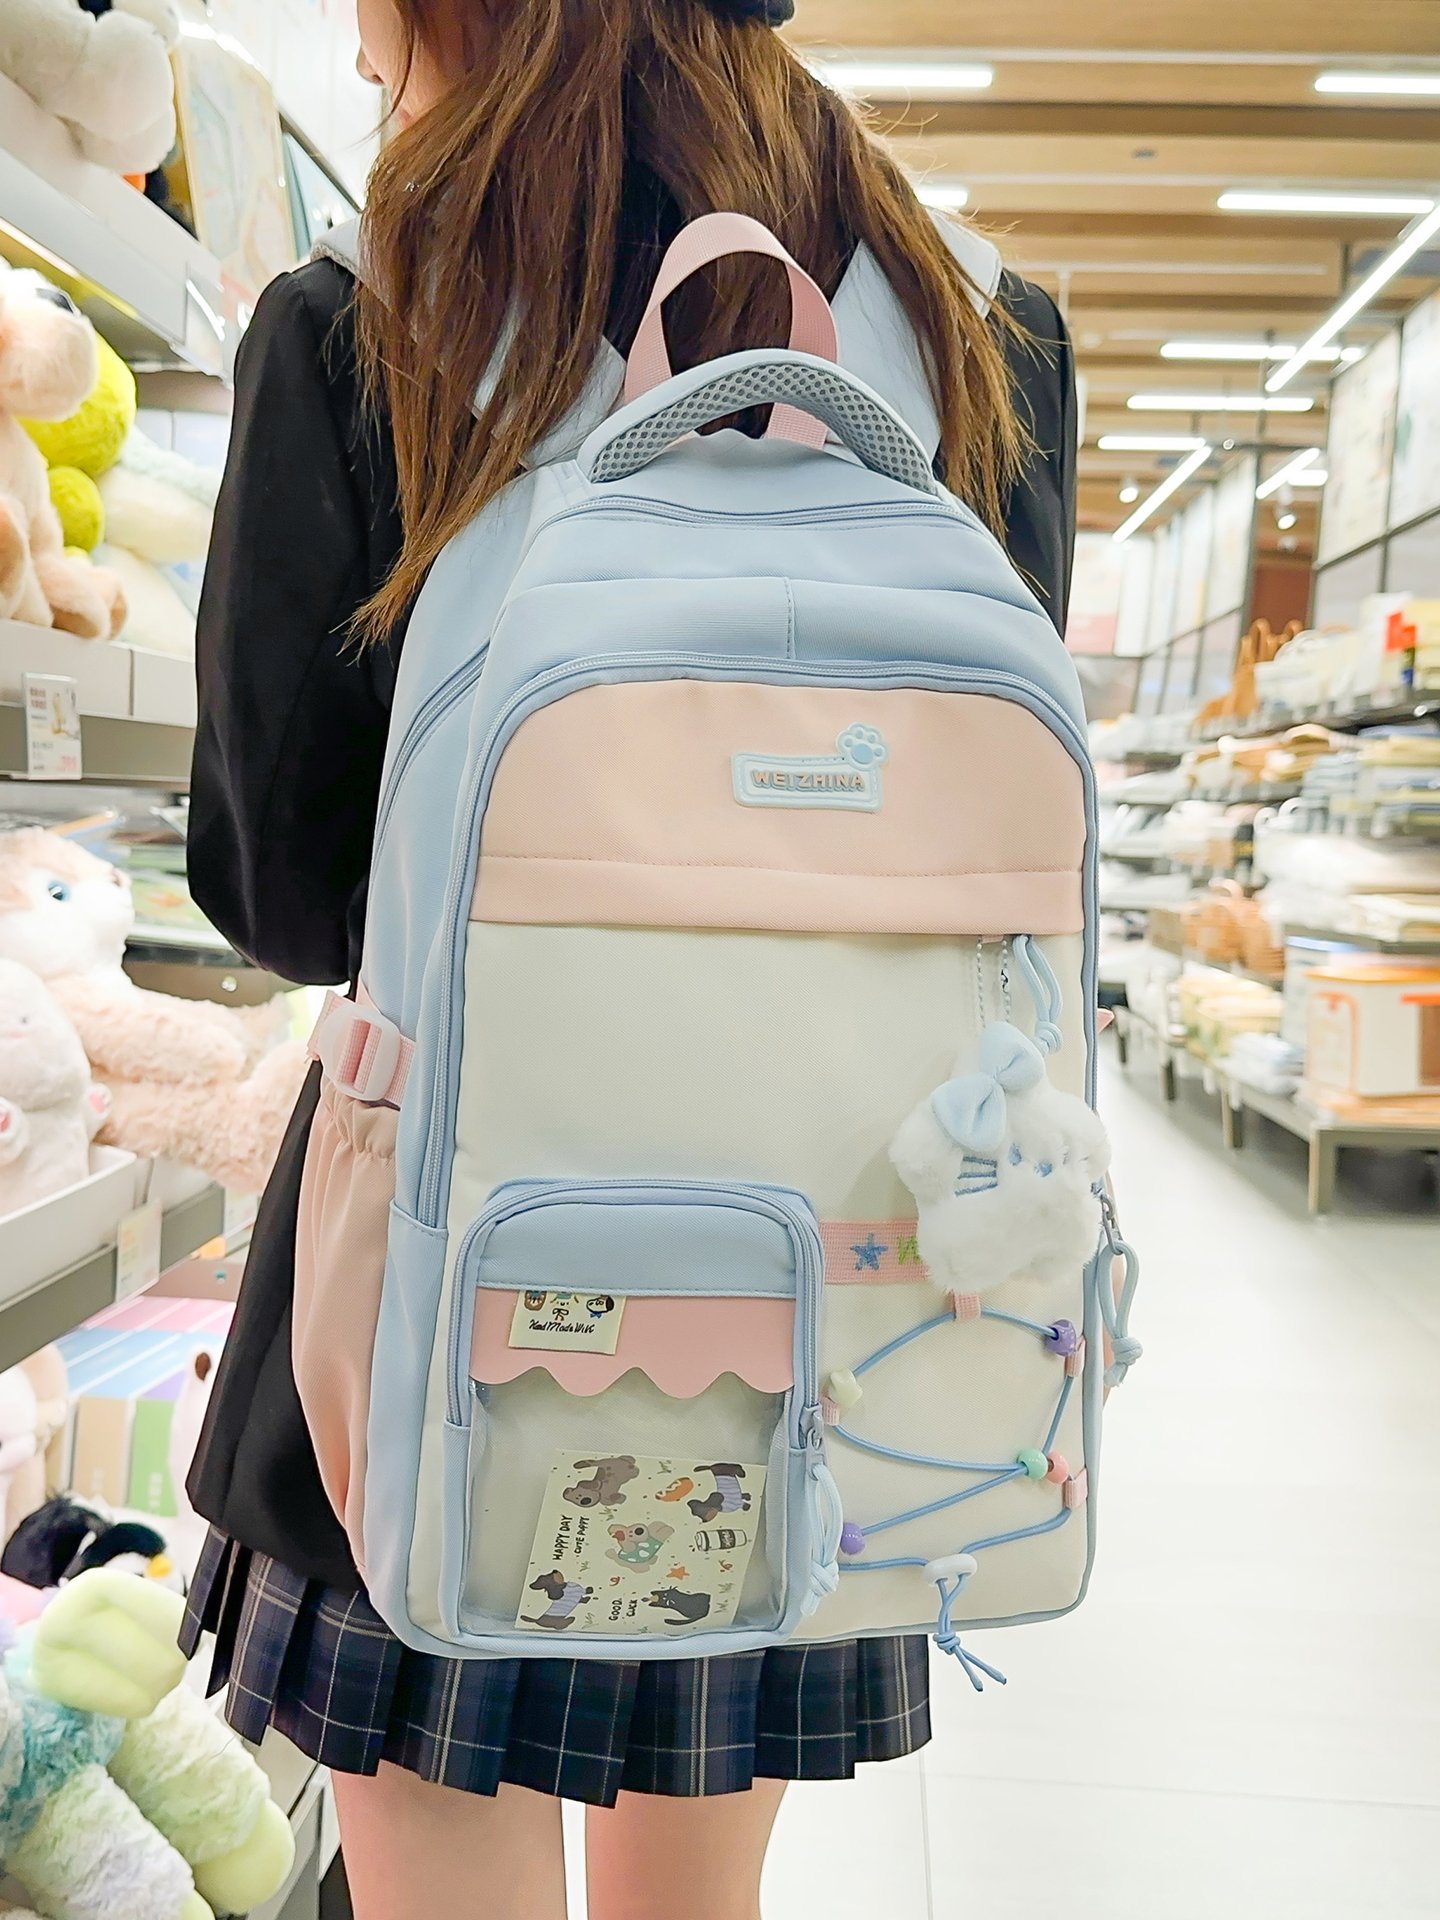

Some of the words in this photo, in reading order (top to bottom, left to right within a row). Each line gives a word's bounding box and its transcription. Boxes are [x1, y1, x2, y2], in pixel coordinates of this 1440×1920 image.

[751, 768, 865, 792] WEIZHINA
[559, 1514, 573, 1531] DAY
[552, 1533, 570, 1560] HAPPY
[574, 1537, 585, 1554] CUTE
[608, 1599, 622, 1620] GOOD
